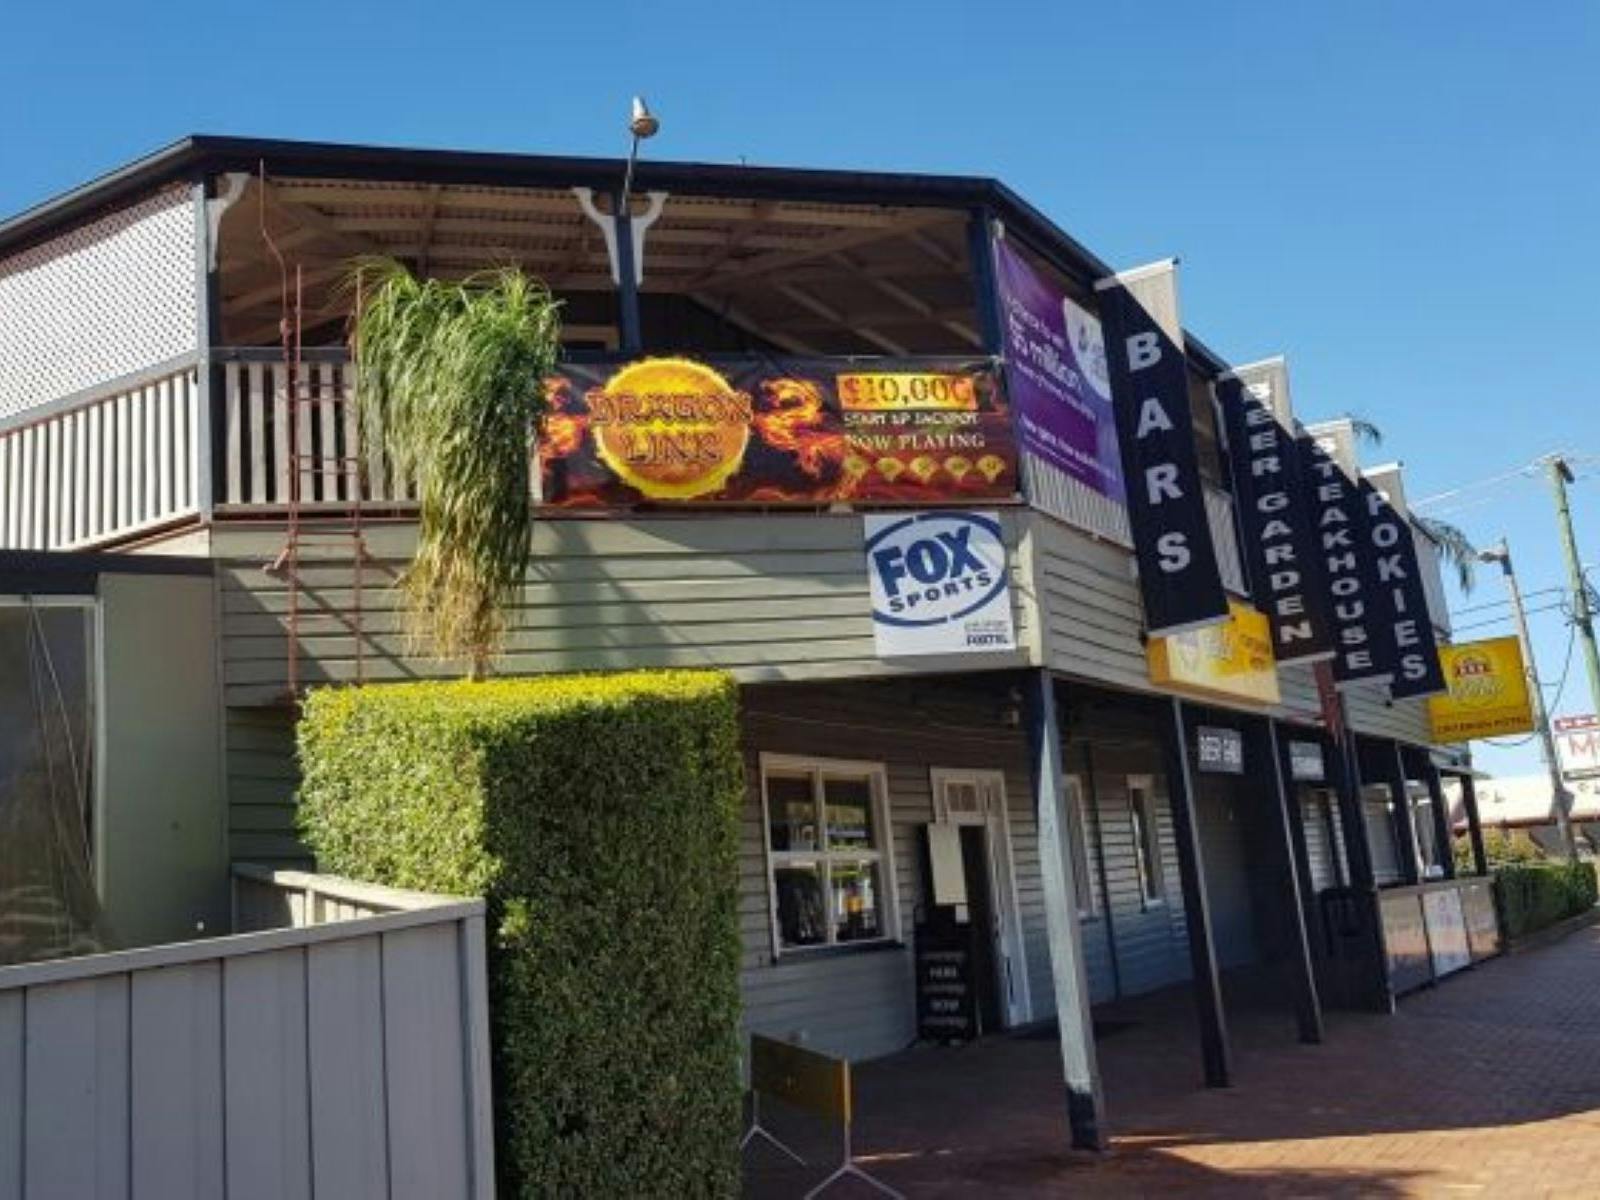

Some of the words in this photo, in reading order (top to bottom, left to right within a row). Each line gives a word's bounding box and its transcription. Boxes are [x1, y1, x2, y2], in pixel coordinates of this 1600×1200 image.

[585, 387, 753, 424] DRAGON
[844, 434, 892, 450] NOW
[898, 432, 985, 450] PLAYING
[619, 429, 723, 466] LINK
[1126, 331, 1191, 574] BARS
[873, 525, 987, 597] FOX
[1257, 491, 1313, 644] GARDEN
[1312, 437, 1373, 670] STEAKHOUSE
[1366, 491, 1427, 680] POKIES
[889, 571, 991, 612] SPORTS
